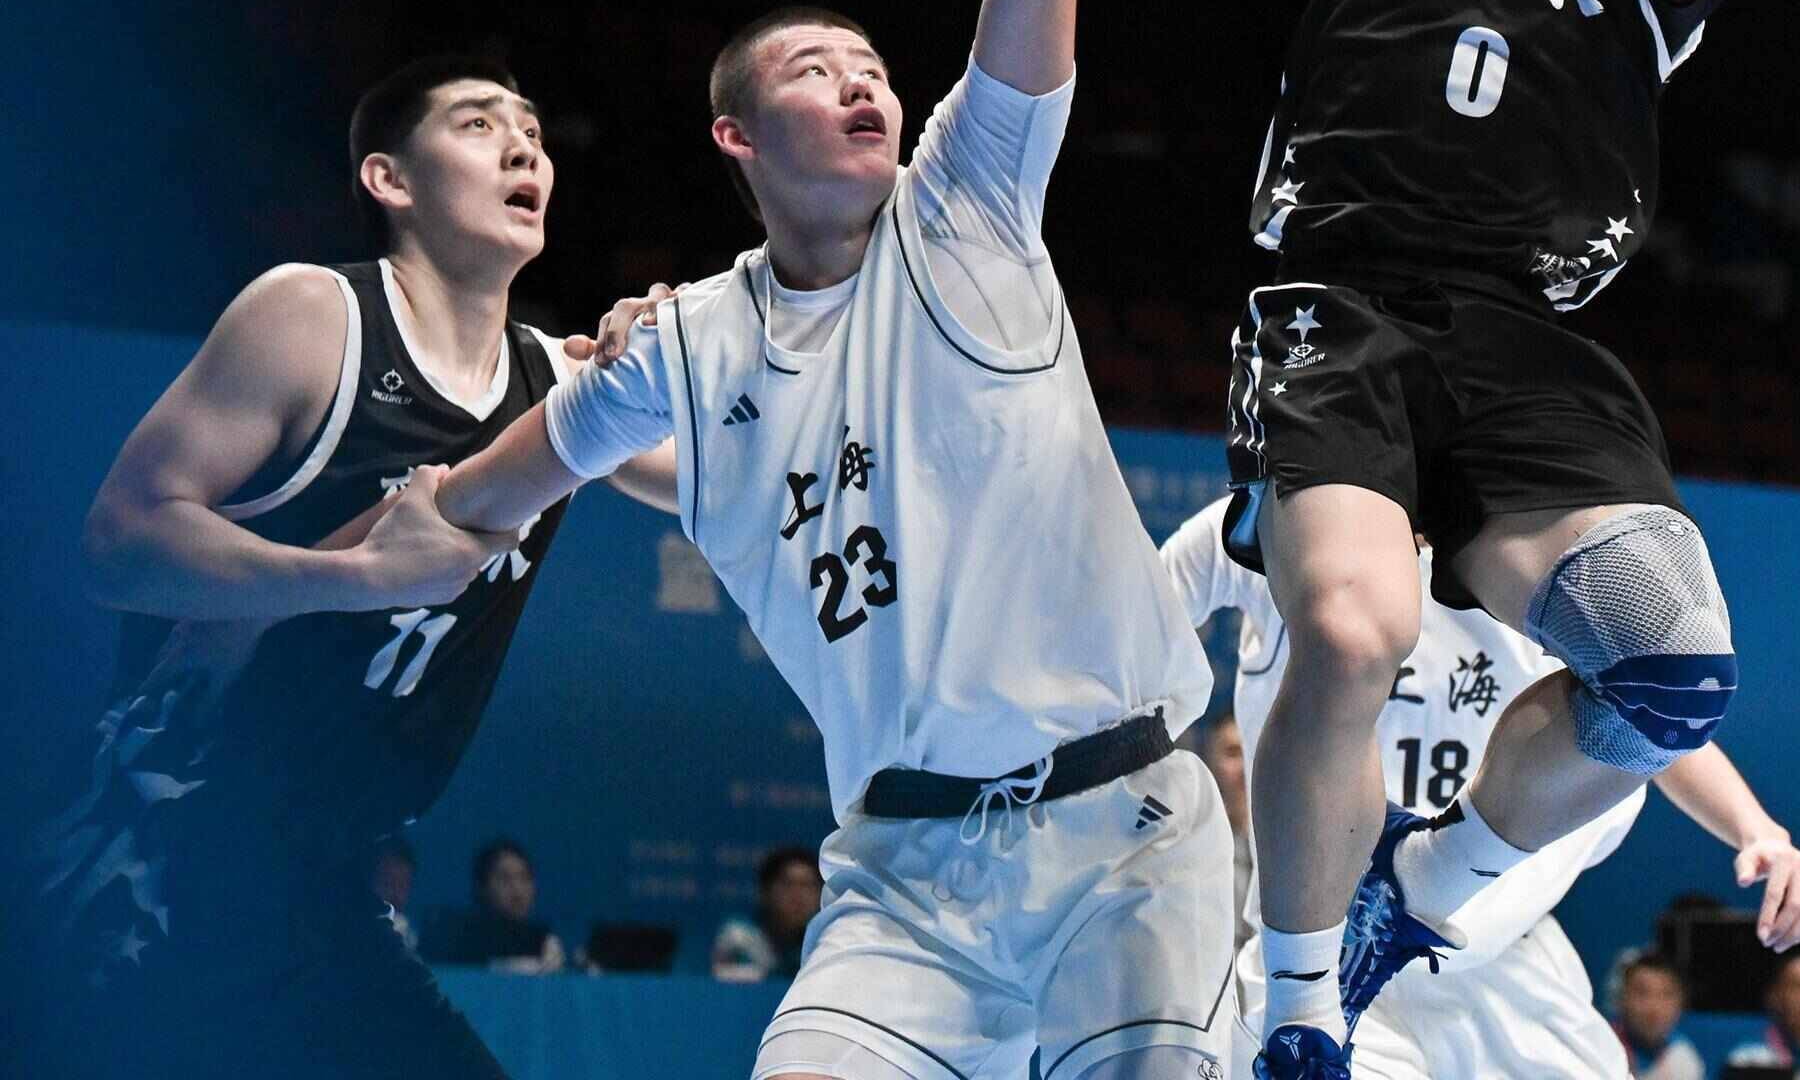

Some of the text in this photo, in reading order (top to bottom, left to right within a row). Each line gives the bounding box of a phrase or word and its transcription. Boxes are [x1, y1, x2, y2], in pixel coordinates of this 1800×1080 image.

[1446, 26, 1510, 118] 0
[809, 525, 898, 644] 23
[363, 607, 458, 698] 11
[1388, 651, 1501, 717] 上海
[1397, 737, 1469, 809] 18
